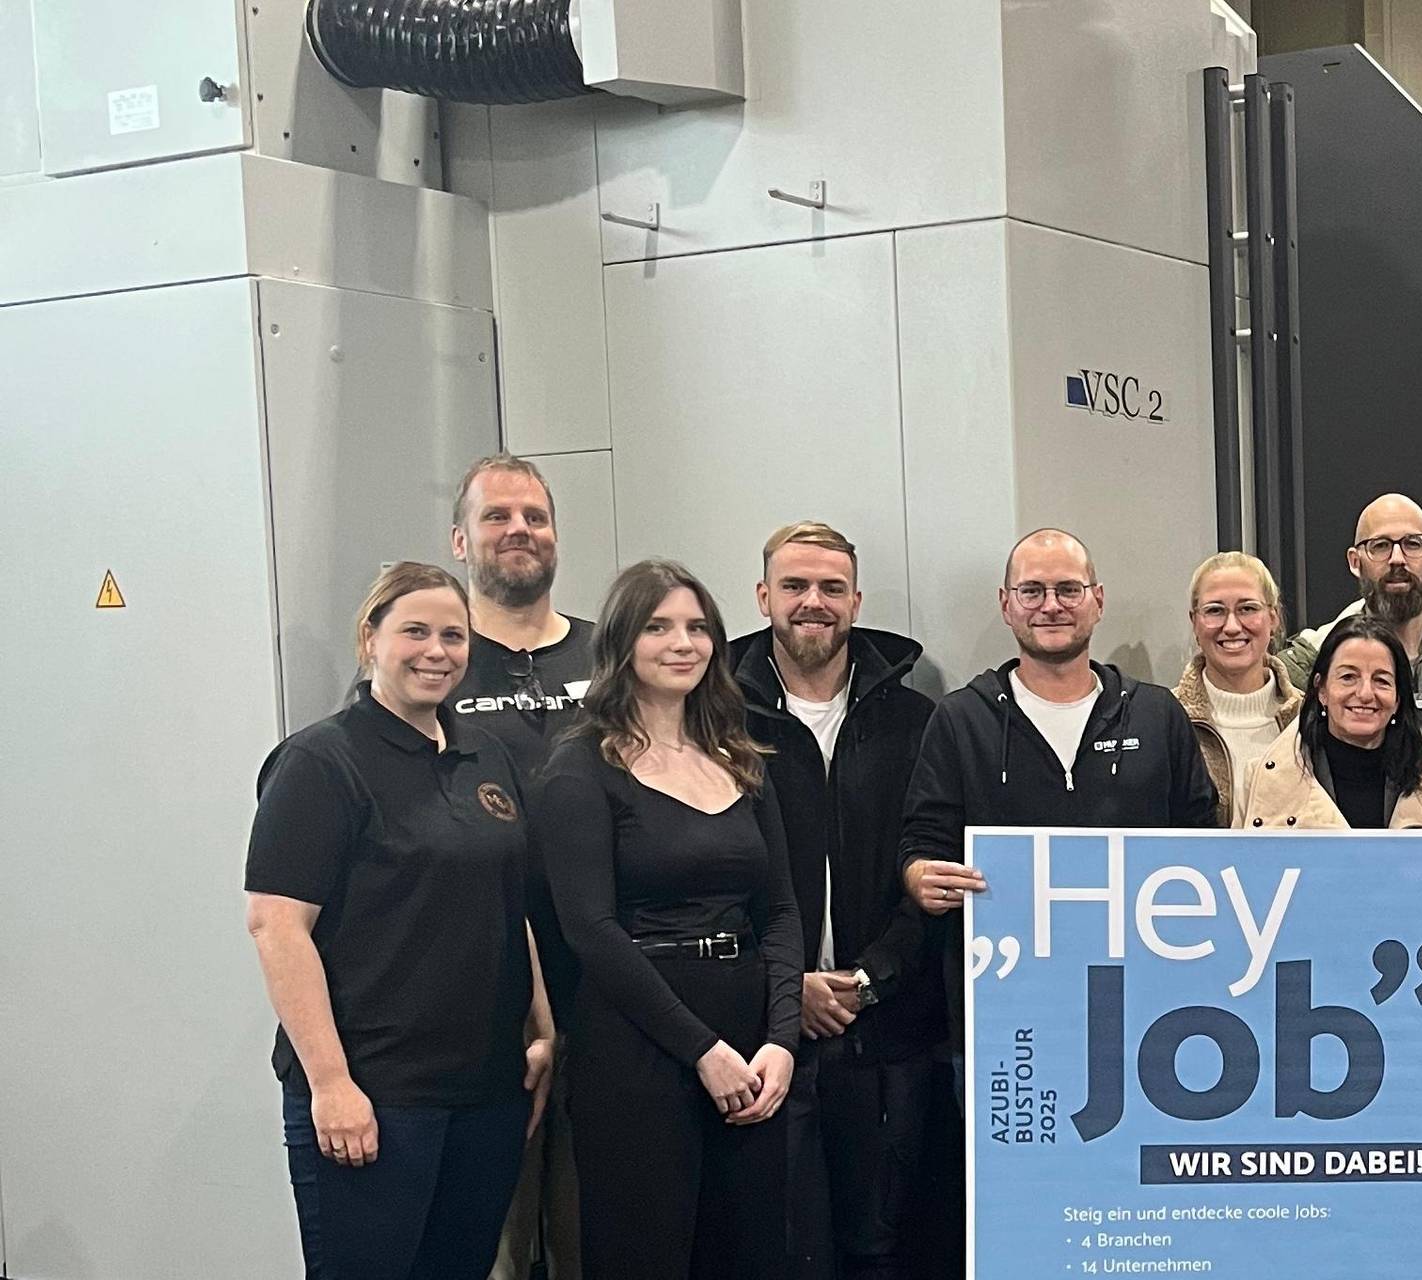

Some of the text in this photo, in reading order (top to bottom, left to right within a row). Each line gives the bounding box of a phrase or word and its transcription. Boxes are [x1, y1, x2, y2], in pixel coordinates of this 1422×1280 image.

[1081, 369, 1163, 421] VSC 2
[991, 1061, 1009, 1144] AZUBI-
[1015, 1028, 1033, 1143] BUSTOUR
[1040, 1089, 1057, 1144] 2025
[1169, 1152, 1231, 1176] WIR
[1240, 1152, 1315, 1176] SIND
[1064, 1204, 1331, 1225] Steig ein und entdecke coole Jobs:
[1081, 1233, 1171, 1248] 4 Branchen
[1082, 1258, 1211, 1274] 14 Unternehmen
